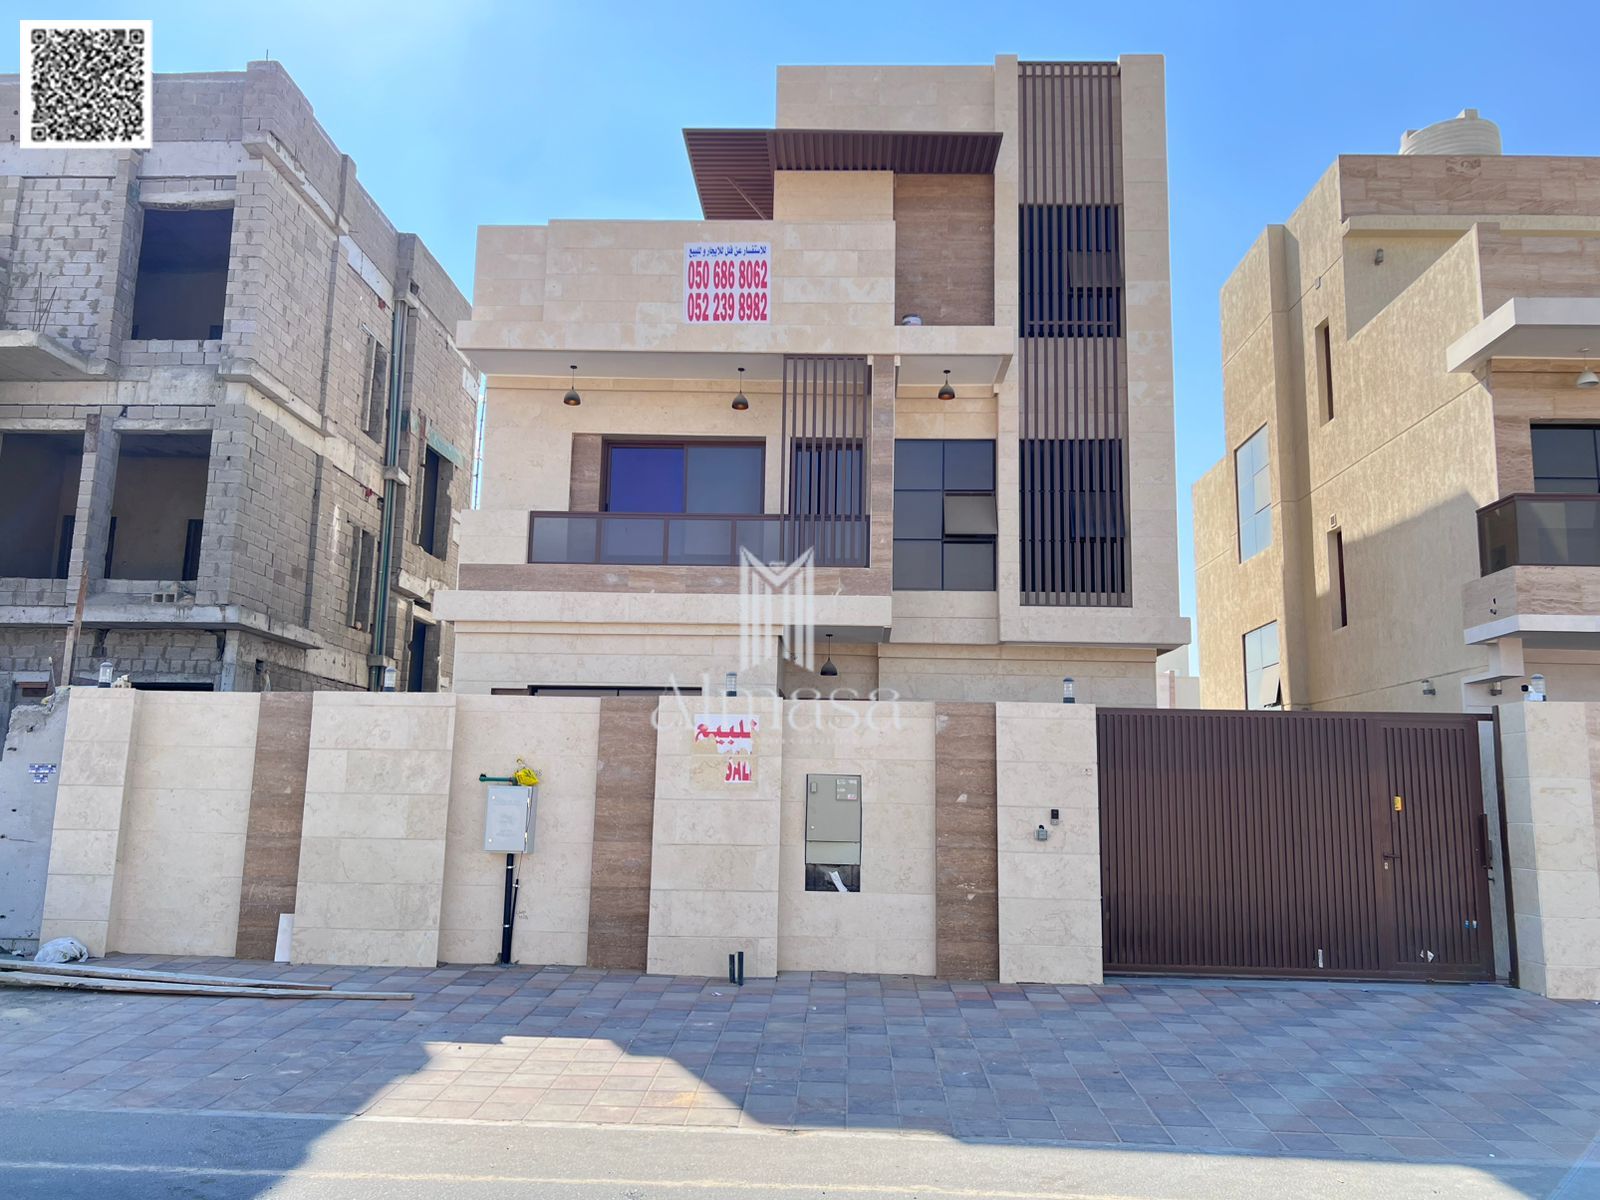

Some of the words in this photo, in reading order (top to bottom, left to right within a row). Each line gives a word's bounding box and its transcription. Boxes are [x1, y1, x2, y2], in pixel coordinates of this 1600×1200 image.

[687, 260, 710, 290] 050
[713, 260, 735, 290] 686
[738, 260, 768, 290] 8062
[687, 292, 710, 322] 052
[712, 292, 735, 322] 239
[738, 292, 768, 322] 8982
